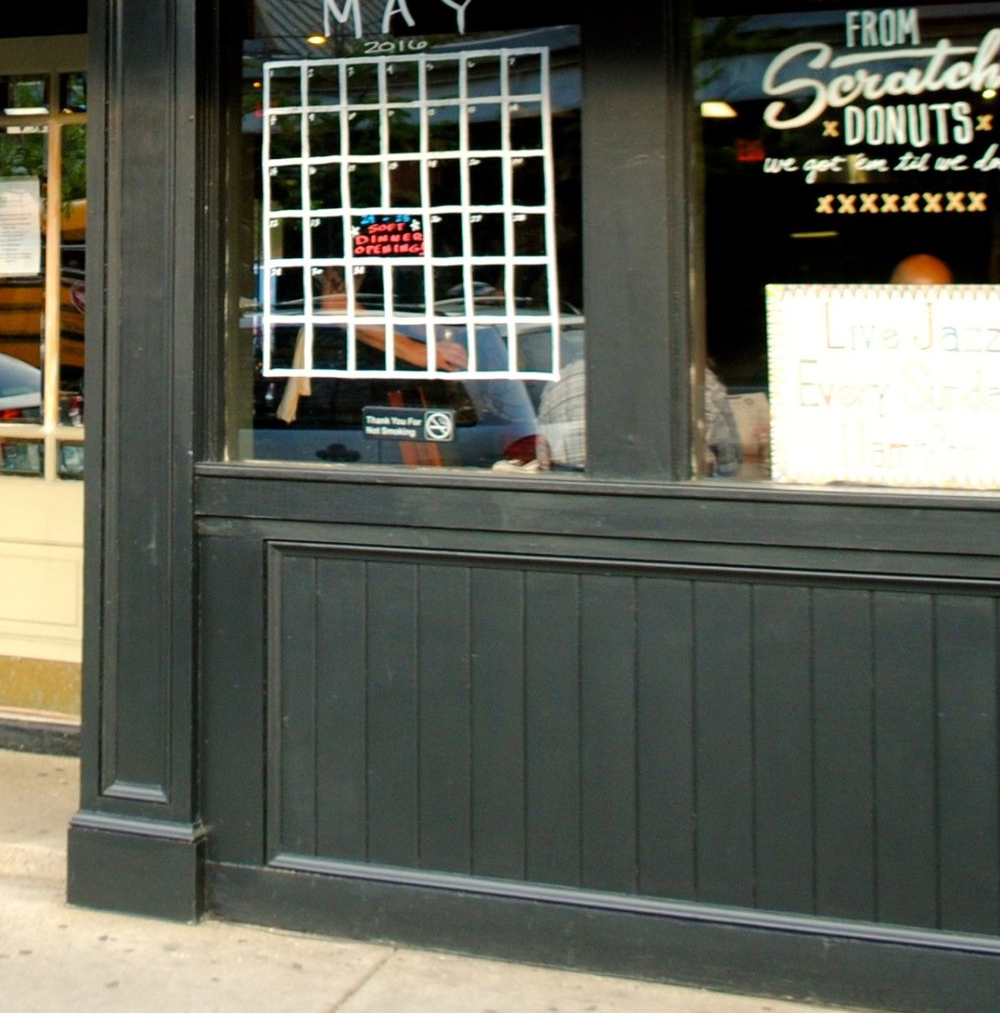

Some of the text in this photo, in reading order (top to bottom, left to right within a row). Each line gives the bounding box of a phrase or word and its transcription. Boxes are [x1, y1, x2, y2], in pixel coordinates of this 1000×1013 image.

[845, 7, 920, 48] FROM
[364, 39, 428, 54] 2016
[762, 27, 1000, 130] Scratch
[844, 101, 974, 148] DONUTS
[763, 157, 799, 173] we
[803, 156, 846, 184] got
[934, 154, 969, 172] we
[354, 232, 424, 245] DINNER
[368, 222, 407, 234] SOFT
